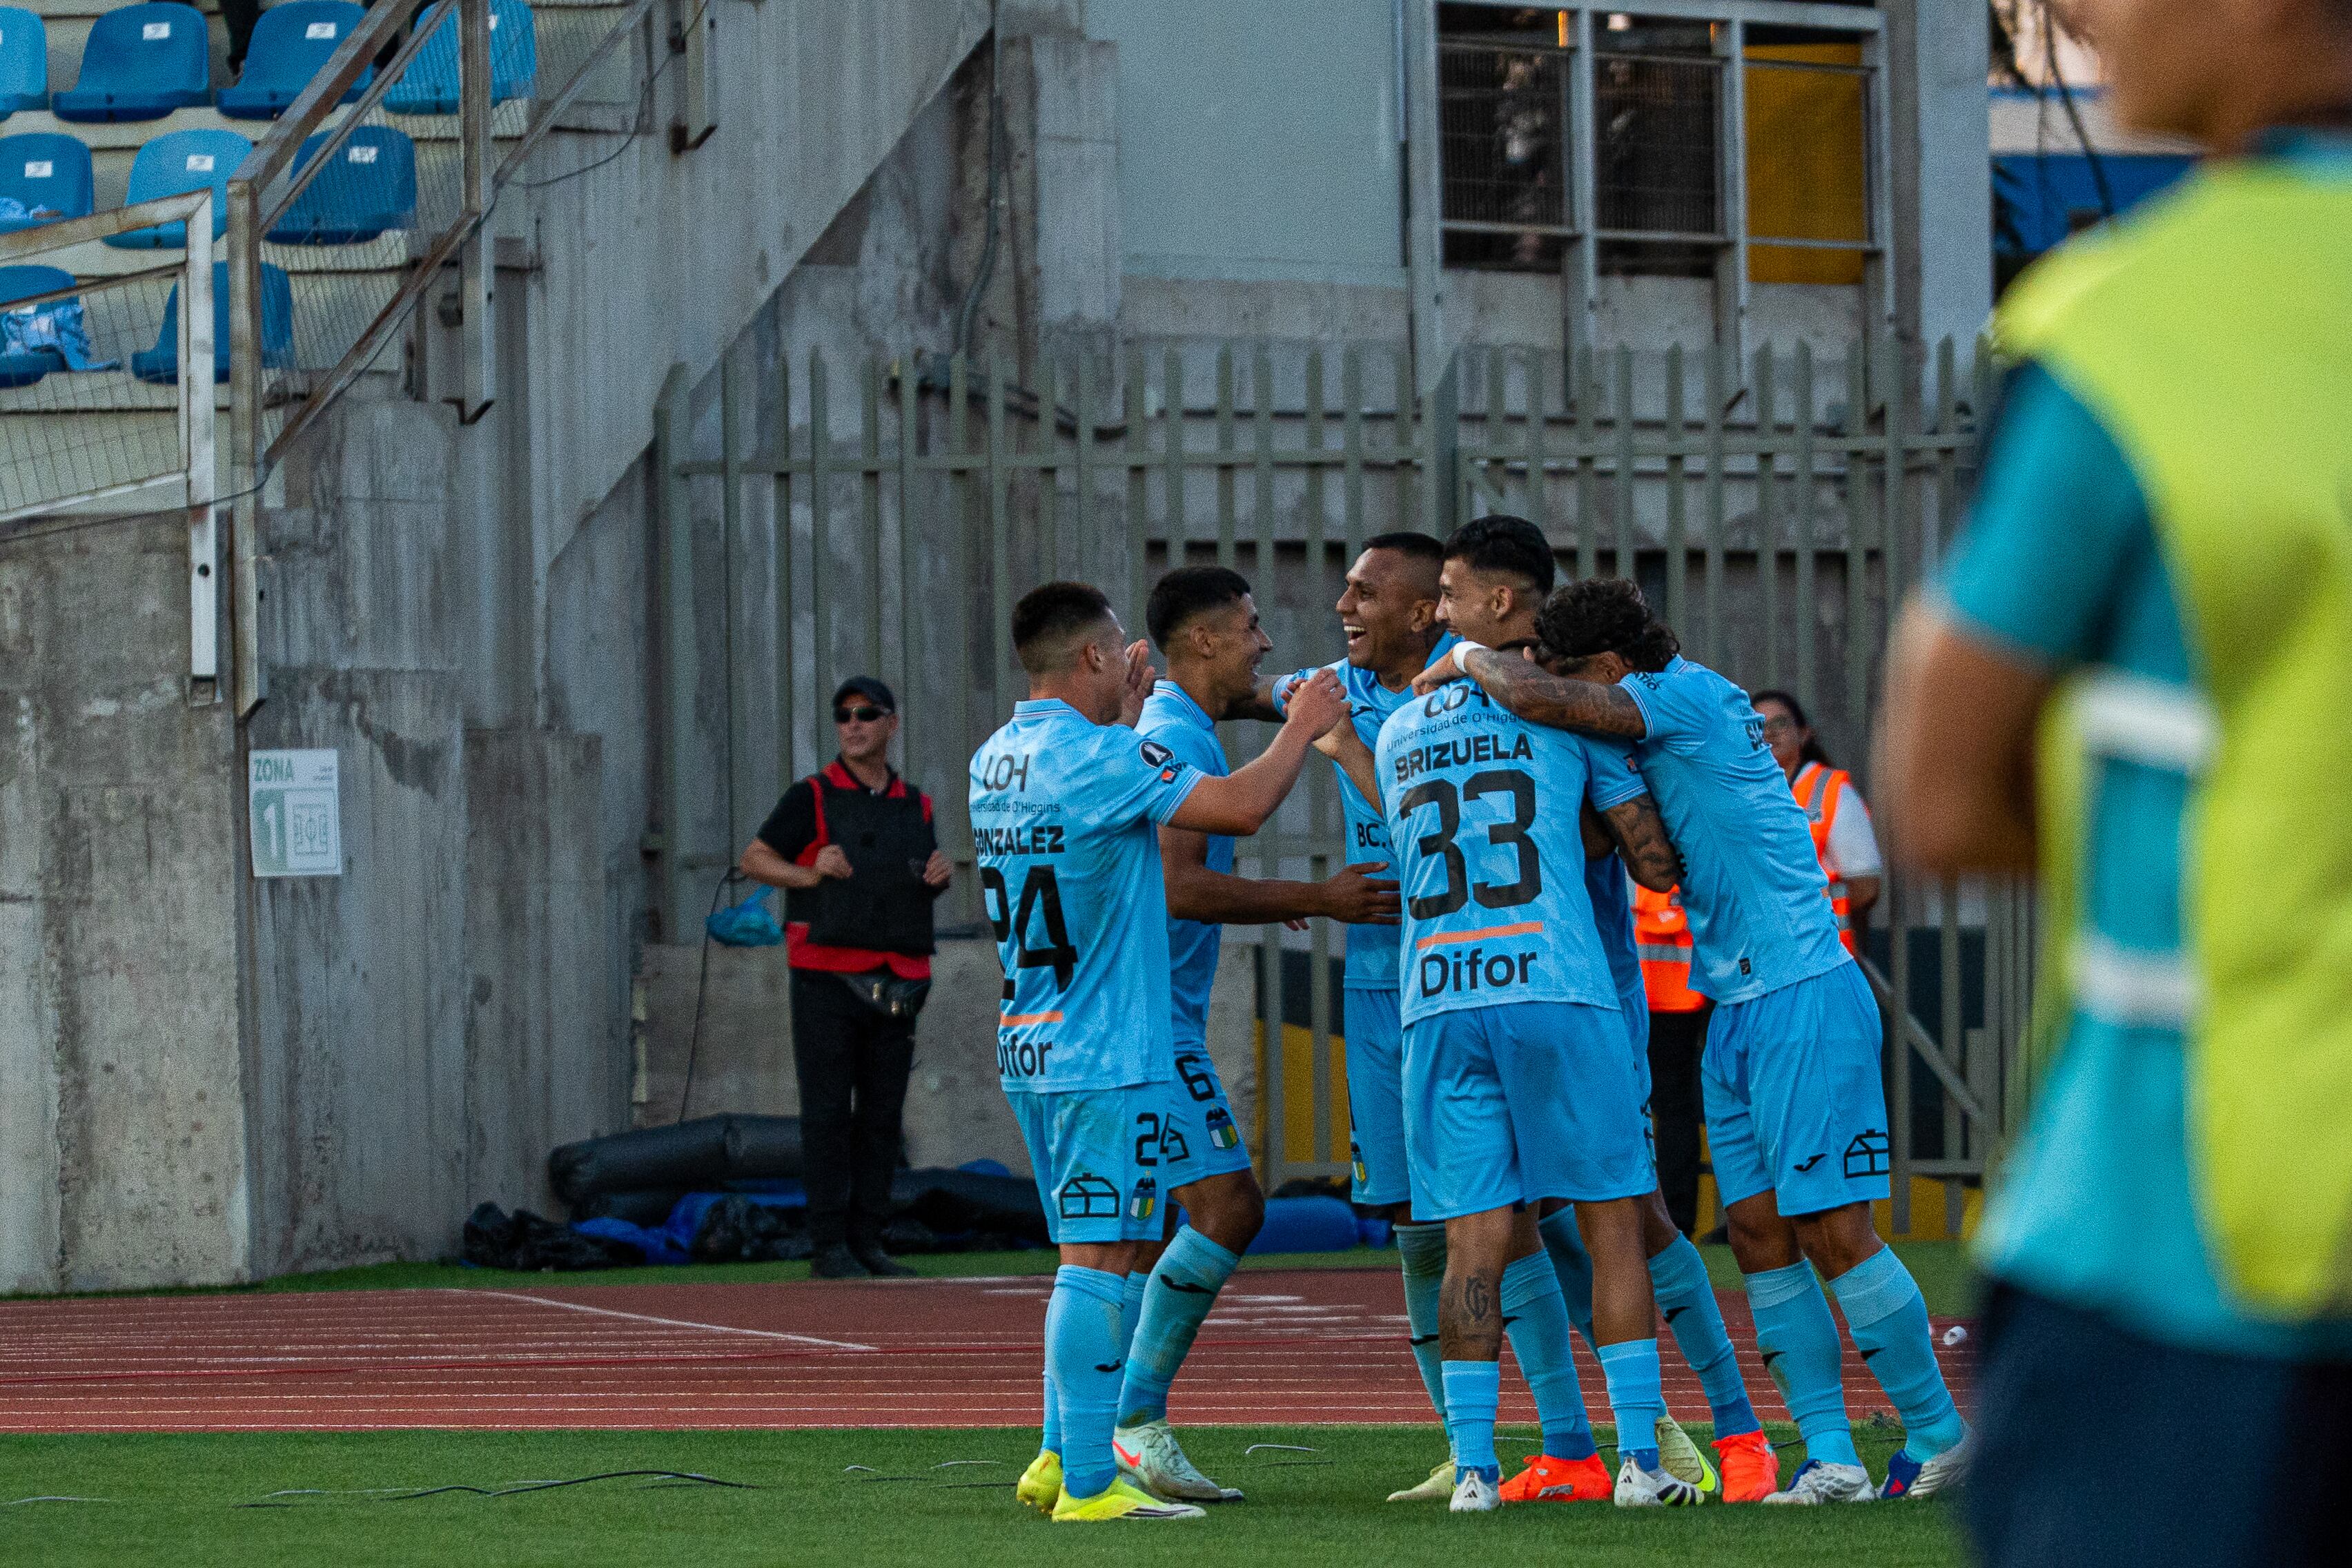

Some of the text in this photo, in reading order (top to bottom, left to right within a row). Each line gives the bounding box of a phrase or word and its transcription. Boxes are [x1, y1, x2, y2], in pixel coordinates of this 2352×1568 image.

[1386, 712, 1520, 752] Universidad de O'Higg
[255, 758, 293, 782] ZONA
[1394, 733, 1533, 785] BRIZUELA
[264, 804, 277, 856] 1
[1002, 801, 1010, 812] de
[1012, 801, 1061, 816] O'Higgins
[1400, 770, 1542, 920] 33
[1420, 948, 1538, 999] Difor
[1175, 1055, 1215, 1102] 6
